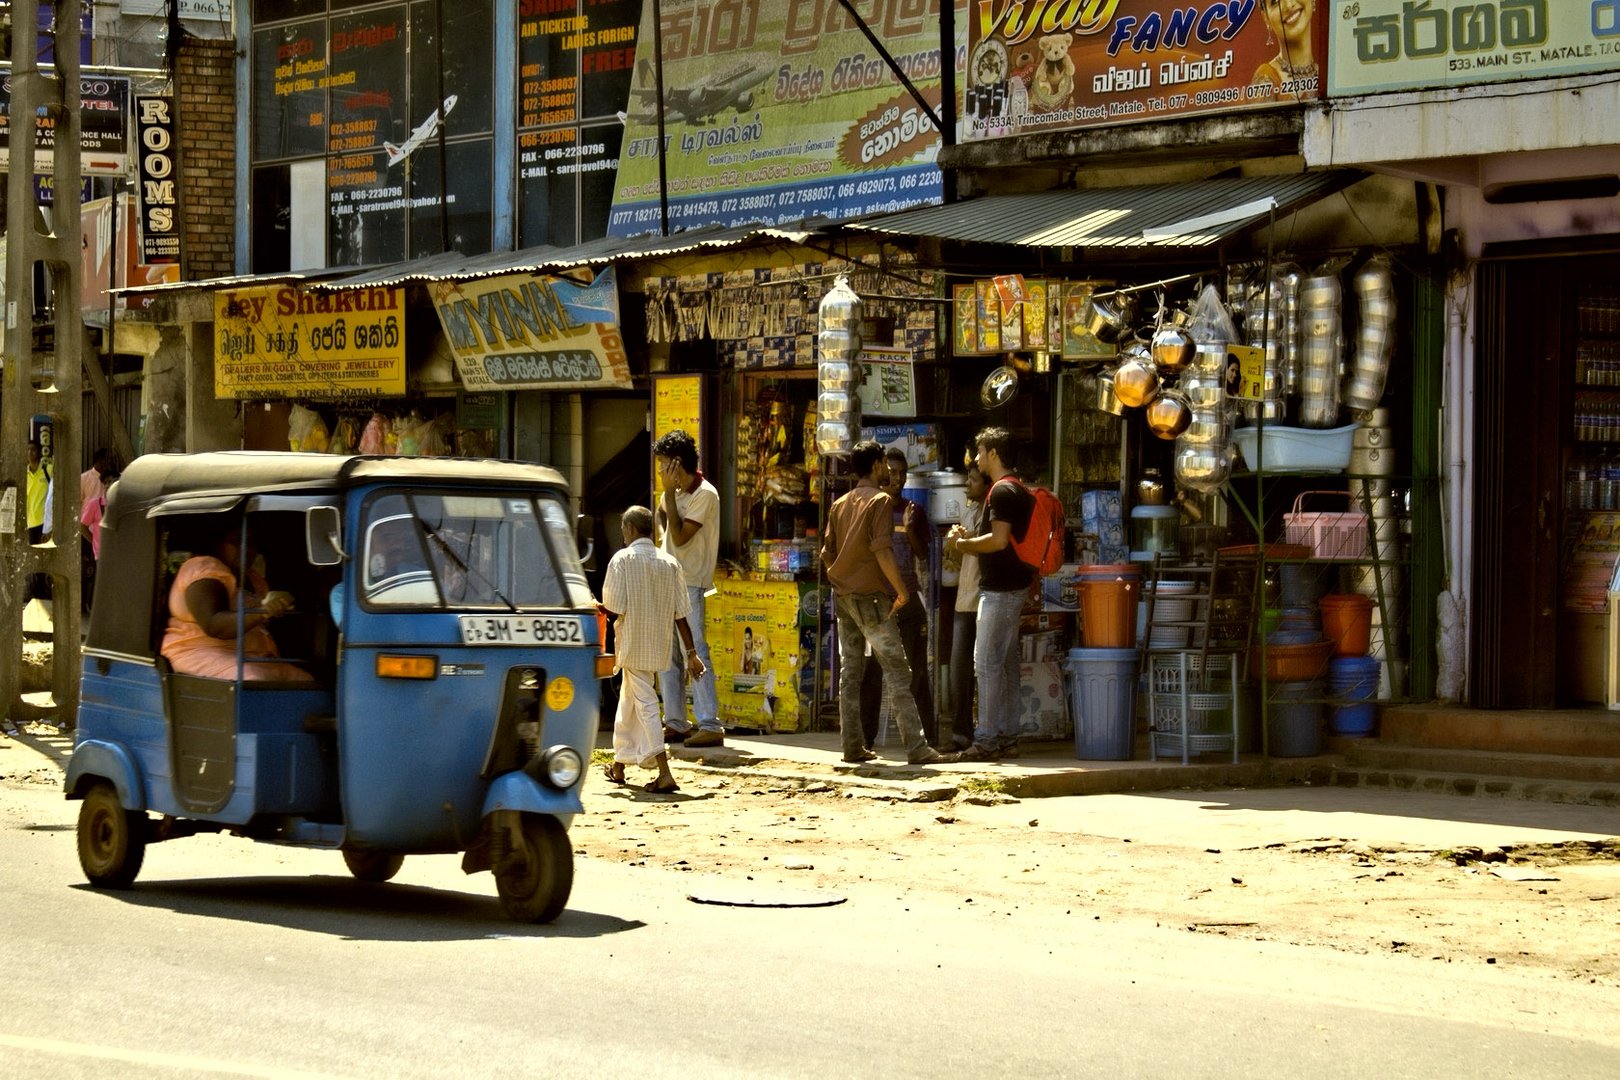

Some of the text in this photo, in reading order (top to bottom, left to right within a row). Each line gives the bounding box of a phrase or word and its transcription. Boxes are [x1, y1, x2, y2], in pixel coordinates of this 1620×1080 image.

[193, 2, 214, 14] 066
[521, 15, 589, 38] AIR TICKETING
[978, 0, 1121, 45] Vijay
[1106, 0, 1257, 57] FANCY
[561, 26, 635, 50] LADIES FORIGN
[1476, 54, 1508, 68] MAIN
[1541, 44, 1598, 62] MATALE.
[973, 118, 988, 131] No.
[989, 116, 1015, 130] 533A,
[1017, 109, 1073, 127] Trincomalee
[1075, 105, 1108, 121] Street,
[1110, 101, 1145, 116] Matale.
[1148, 98, 1166, 112] Tel.
[1169, 94, 1187, 110] 077
[1195, 88, 1239, 106] 9809496
[1247, 83, 1272, 99] 0777
[101, 130, 122, 140] HALL
[521, 151, 537, 163] FAX
[544, 143, 605, 160] 066-2230796
[139, 99, 175, 232] ROOMS
[521, 165, 548, 178] E-MAIL
[331, 192, 344, 202] FAX
[351, 187, 402, 201] 066-2230796
[613, 211, 634, 225] 0777
[682, 199, 719, 217] 8415479,
[721, 198, 738, 213] 072
[739, 193, 777, 212] 3588037,
[778, 190, 795, 206] 072
[795, 186, 836, 205] 7588037,
[838, 183, 855, 199] 066
[856, 179, 897, 197] 4929073,
[899, 174, 917, 190] 066
[331, 205, 354, 216] E-MAIL
[277, 286, 398, 317] Shakthi
[225, 360, 395, 375] DEALERS IN GOLD COVERING JEWELLERY
[880, 354, 907, 362] RACK
